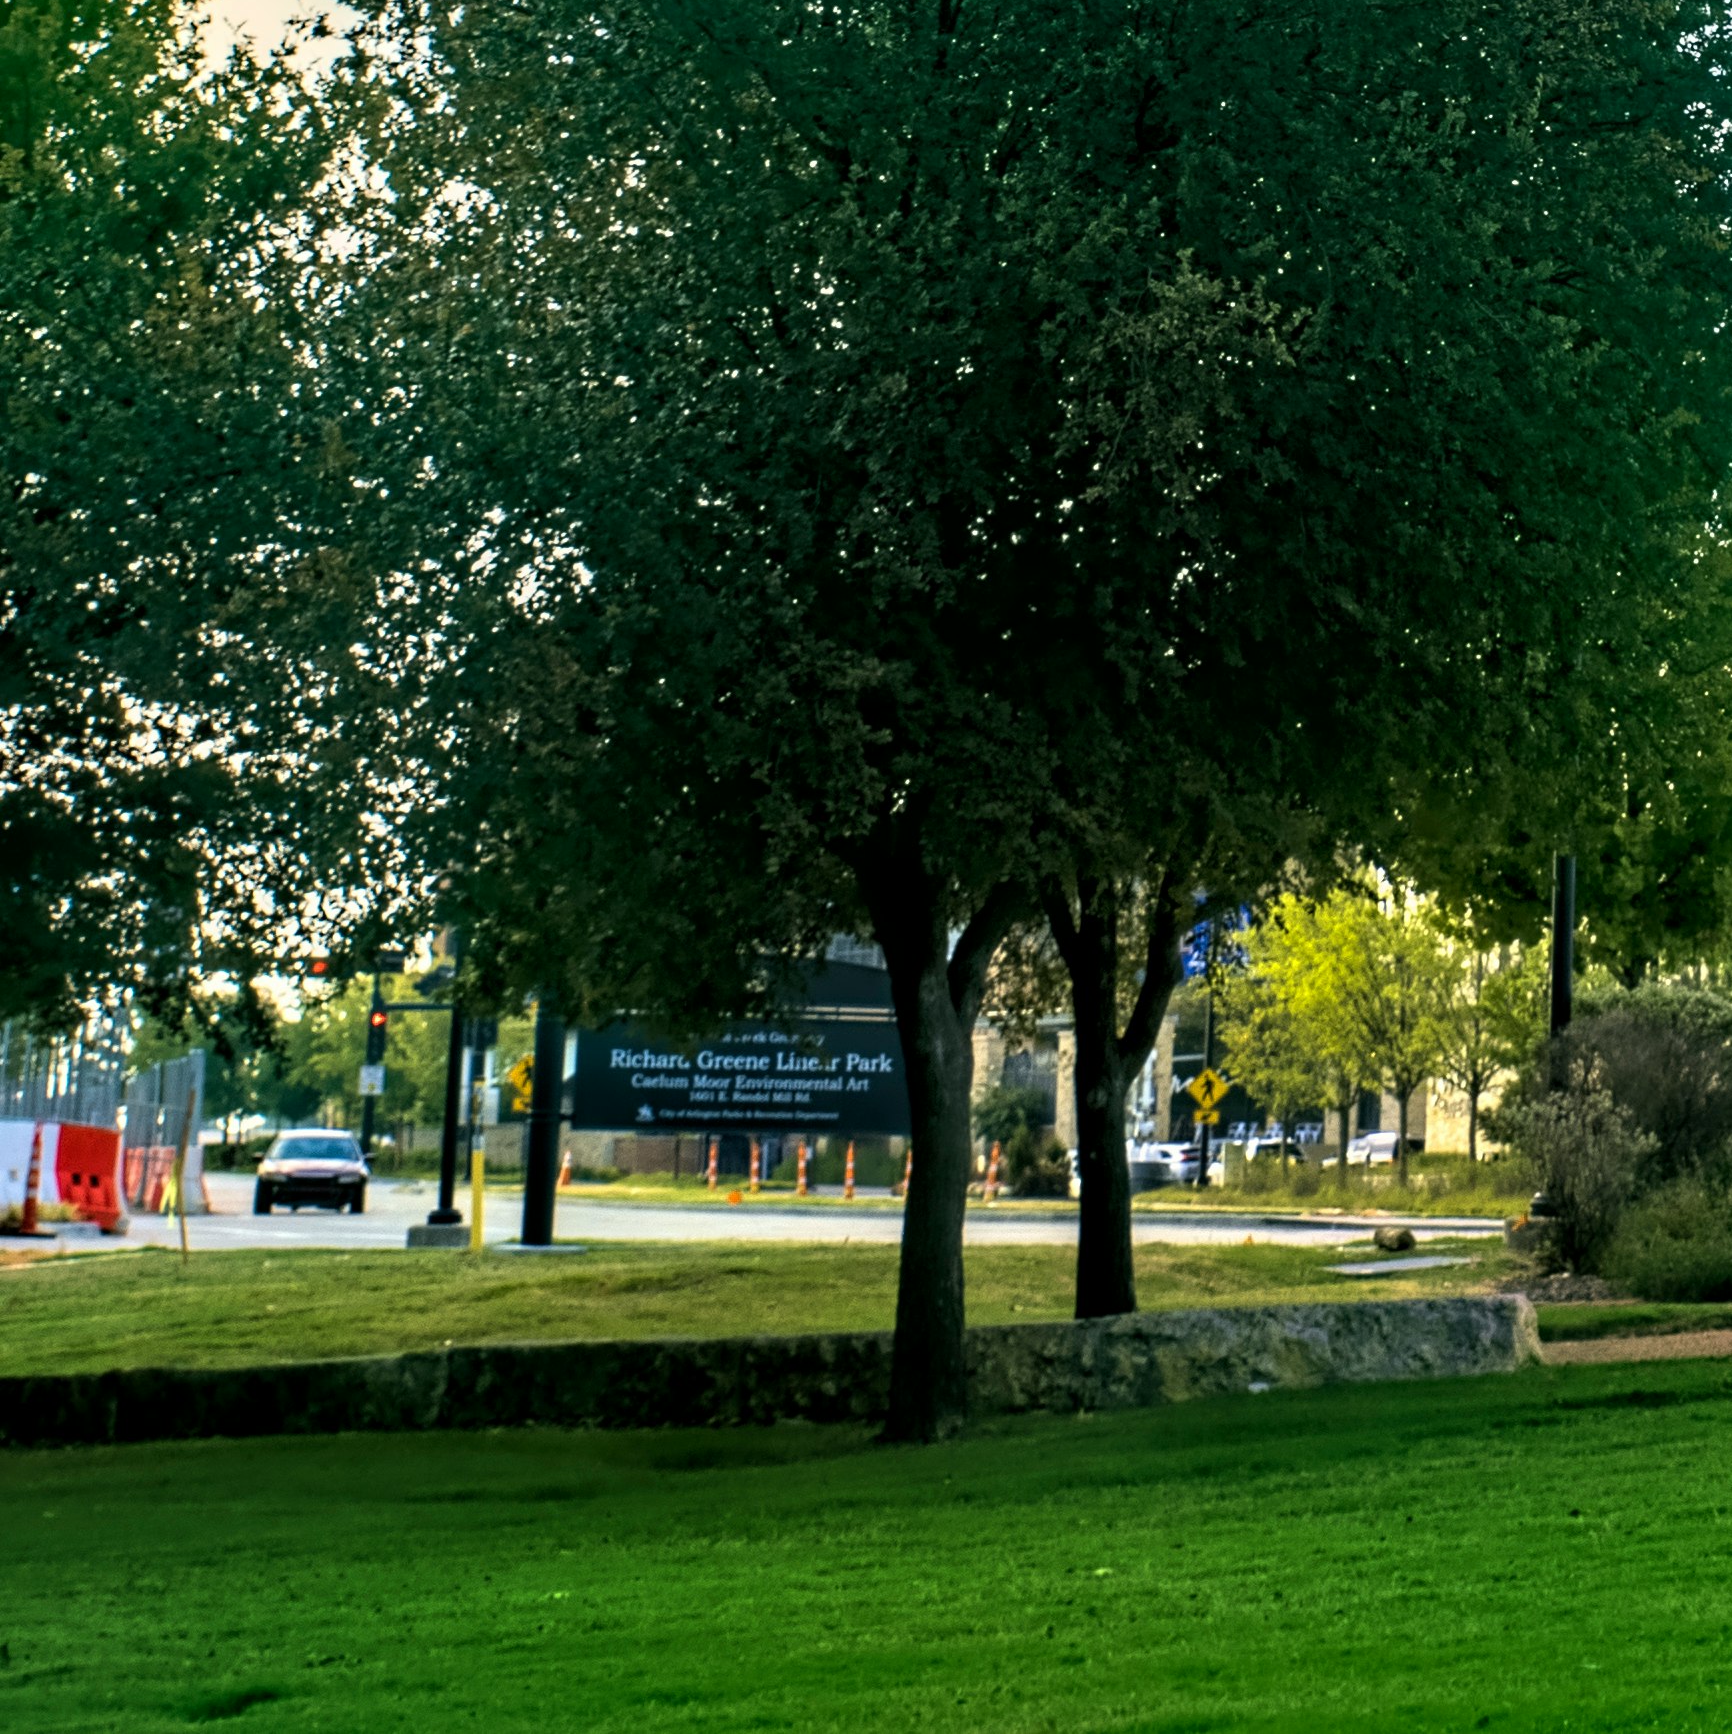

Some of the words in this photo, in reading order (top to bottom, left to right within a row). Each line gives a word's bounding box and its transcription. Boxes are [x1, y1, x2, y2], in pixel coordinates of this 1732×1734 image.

[697, 1050, 770, 1071] Greene
[776, 1051, 841, 1072] Liner
[846, 1052, 893, 1073] Park
[631, 1073, 689, 1089] Caelum
[693, 1074, 731, 1089] Moor
[735, 1074, 843, 1091] Environmental
[846, 1076, 869, 1092] Art
